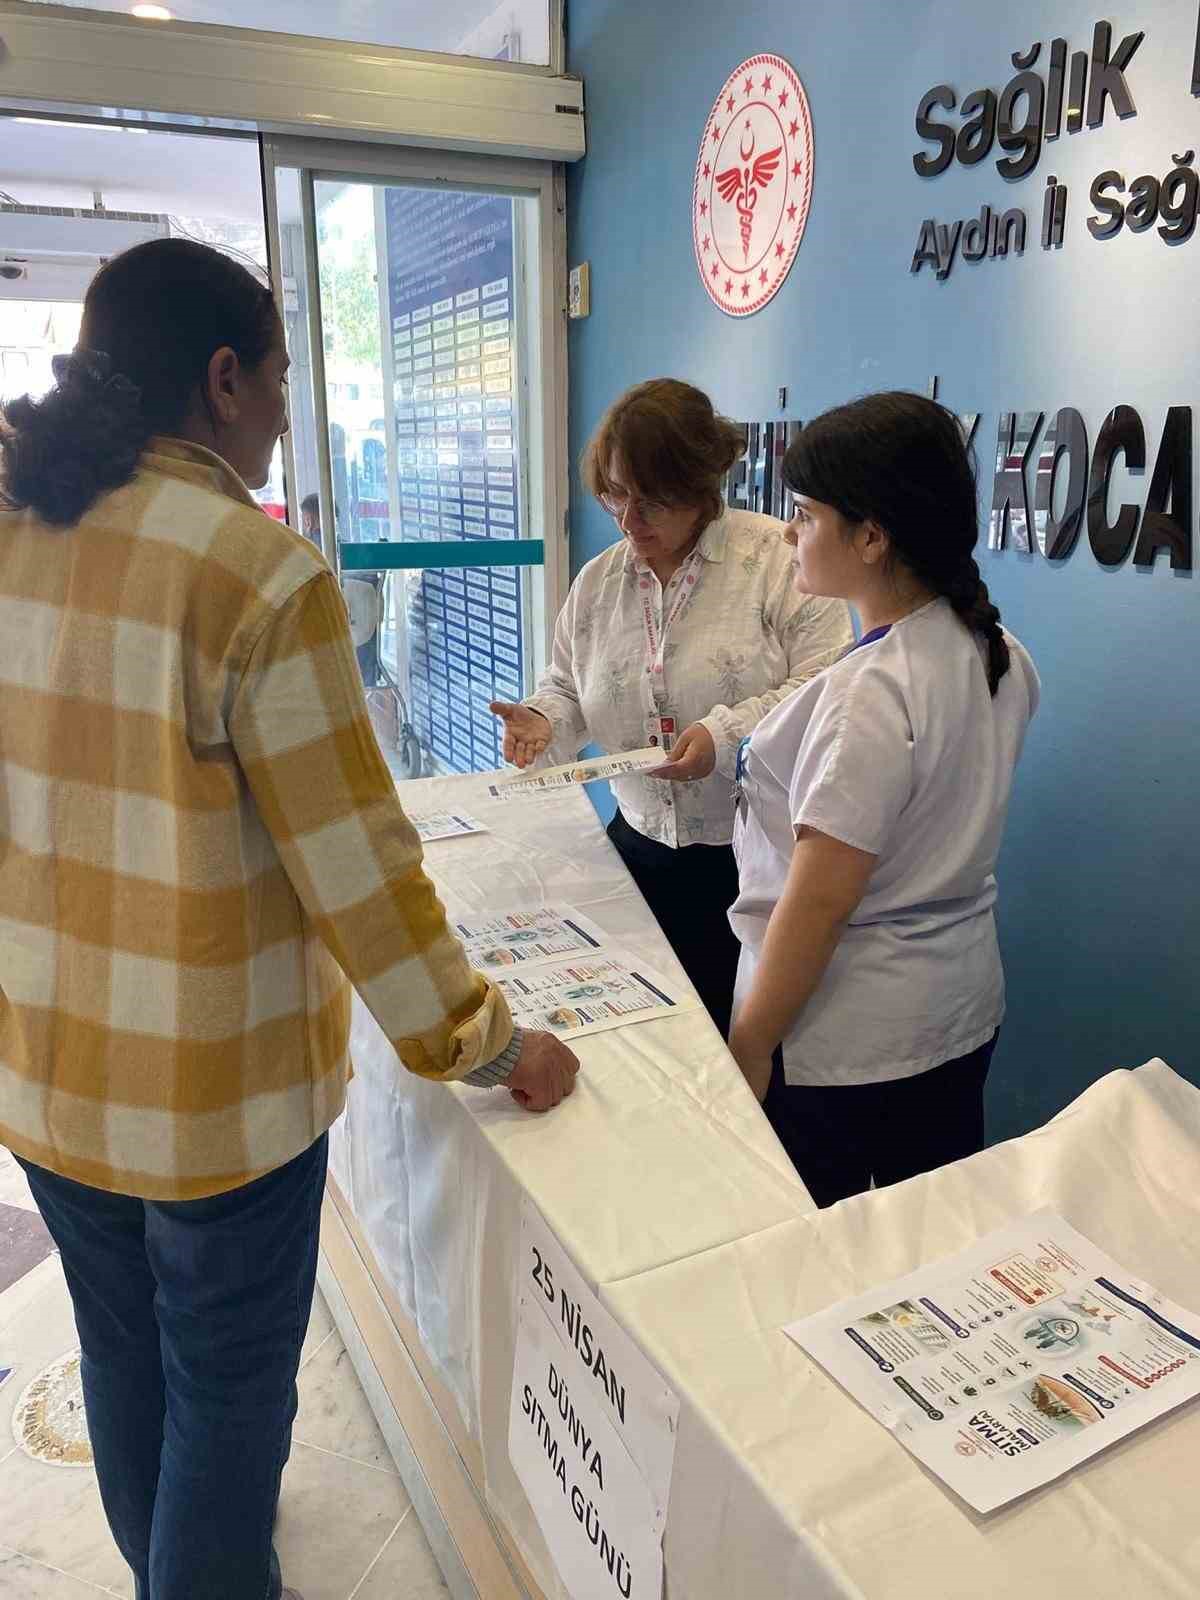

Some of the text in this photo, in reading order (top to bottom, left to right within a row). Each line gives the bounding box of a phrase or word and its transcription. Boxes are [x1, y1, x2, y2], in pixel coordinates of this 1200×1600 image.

[913, 20, 1145, 181] Sağlık
[910, 204, 1027, 282] Aydın
[1087, 150, 1200, 248] Sağ
[988, 404, 1193, 572] KOCA
[532, 1246, 626, 1425] 25 NİSAN
[522, 1384, 632, 1600] SITMA GÜNÜ
[548, 1361, 604, 1491] DÜNYA
[968, 1415, 1021, 1457] SITMA
